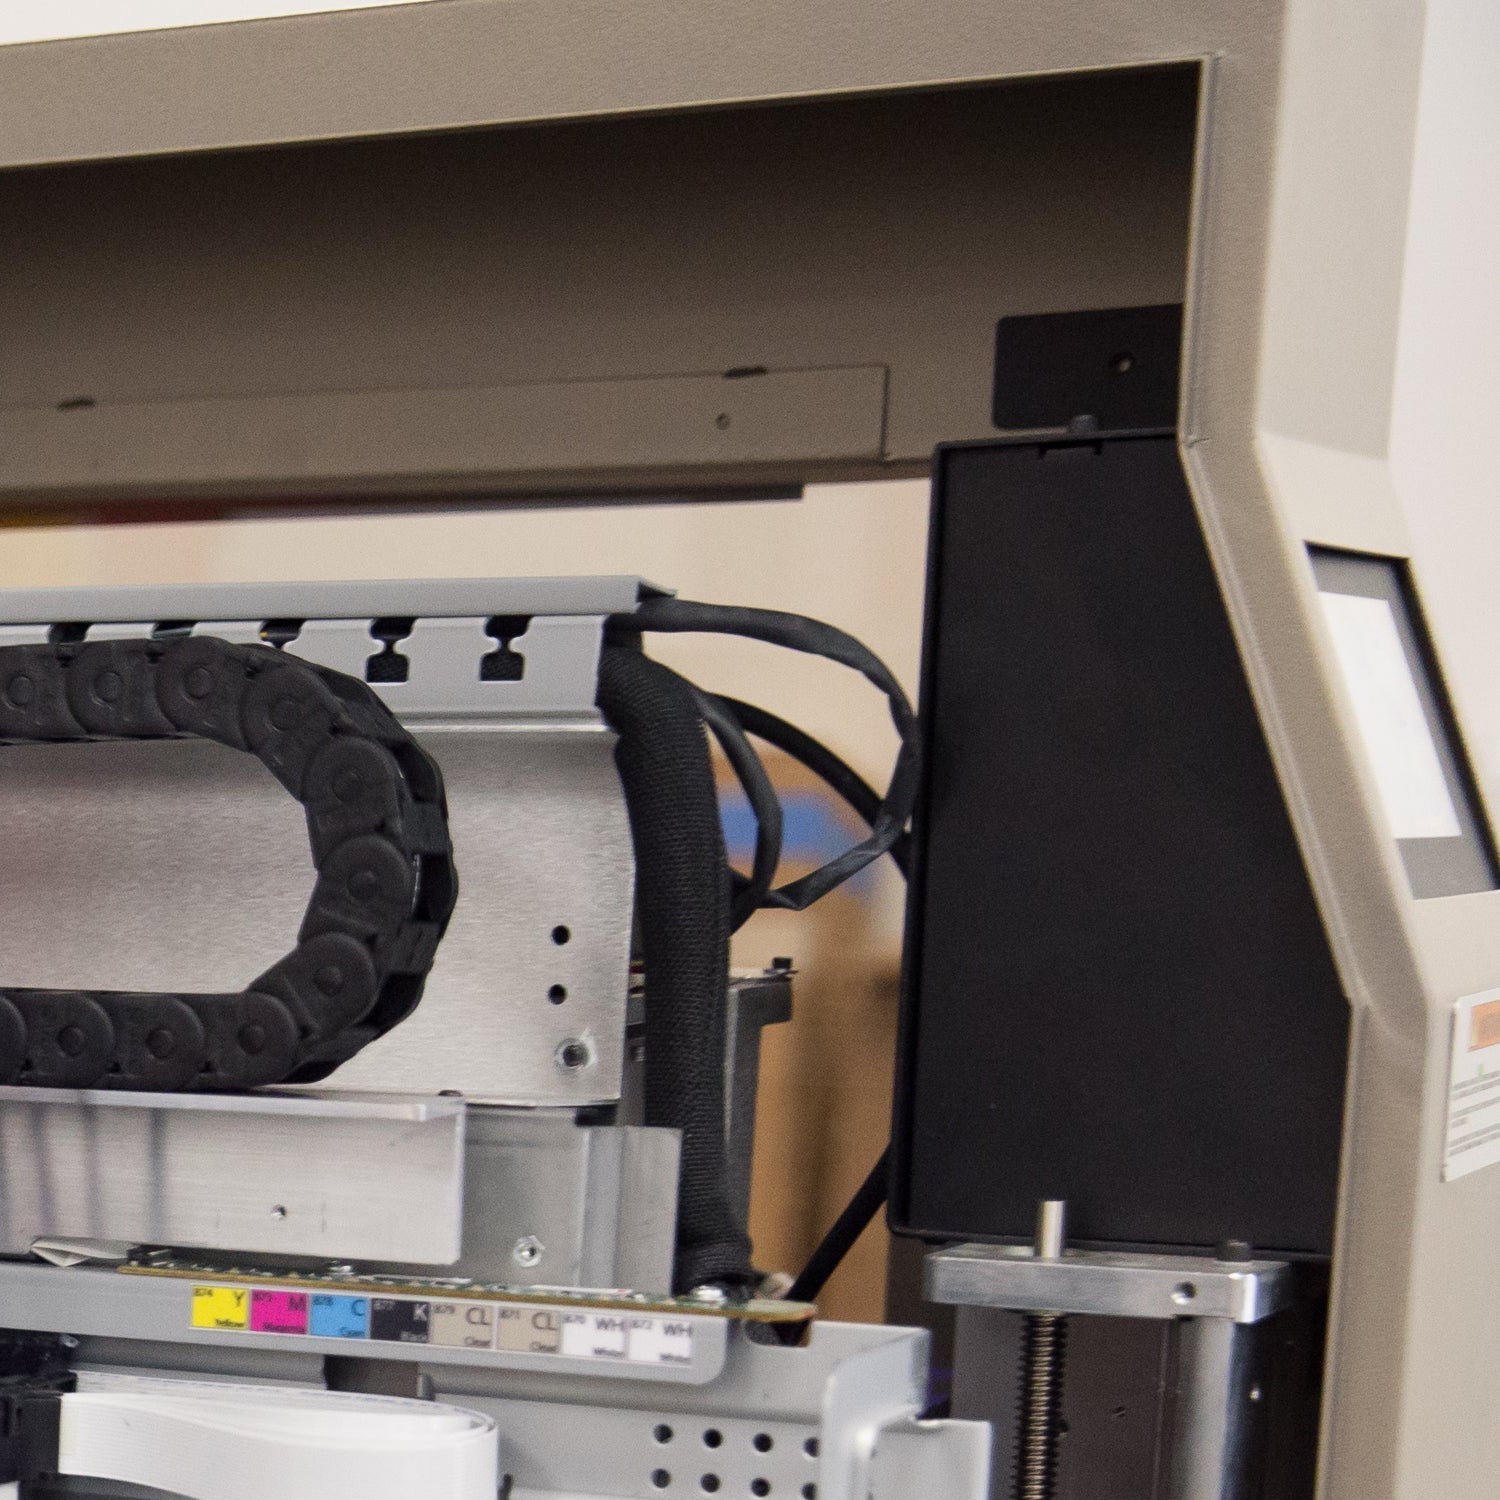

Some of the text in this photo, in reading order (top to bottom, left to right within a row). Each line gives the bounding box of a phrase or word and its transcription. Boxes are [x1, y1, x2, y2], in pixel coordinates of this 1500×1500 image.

[232, 1290, 246, 1308] Y
[287, 1293, 306, 1312] M
[351, 1299, 365, 1317] C
[413, 1302, 429, 1321] K
[465, 1306, 491, 1326] CL
[531, 1311, 558, 1331] CL
[595, 1317, 624, 1332] WH
[663, 1322, 692, 1337] WH
